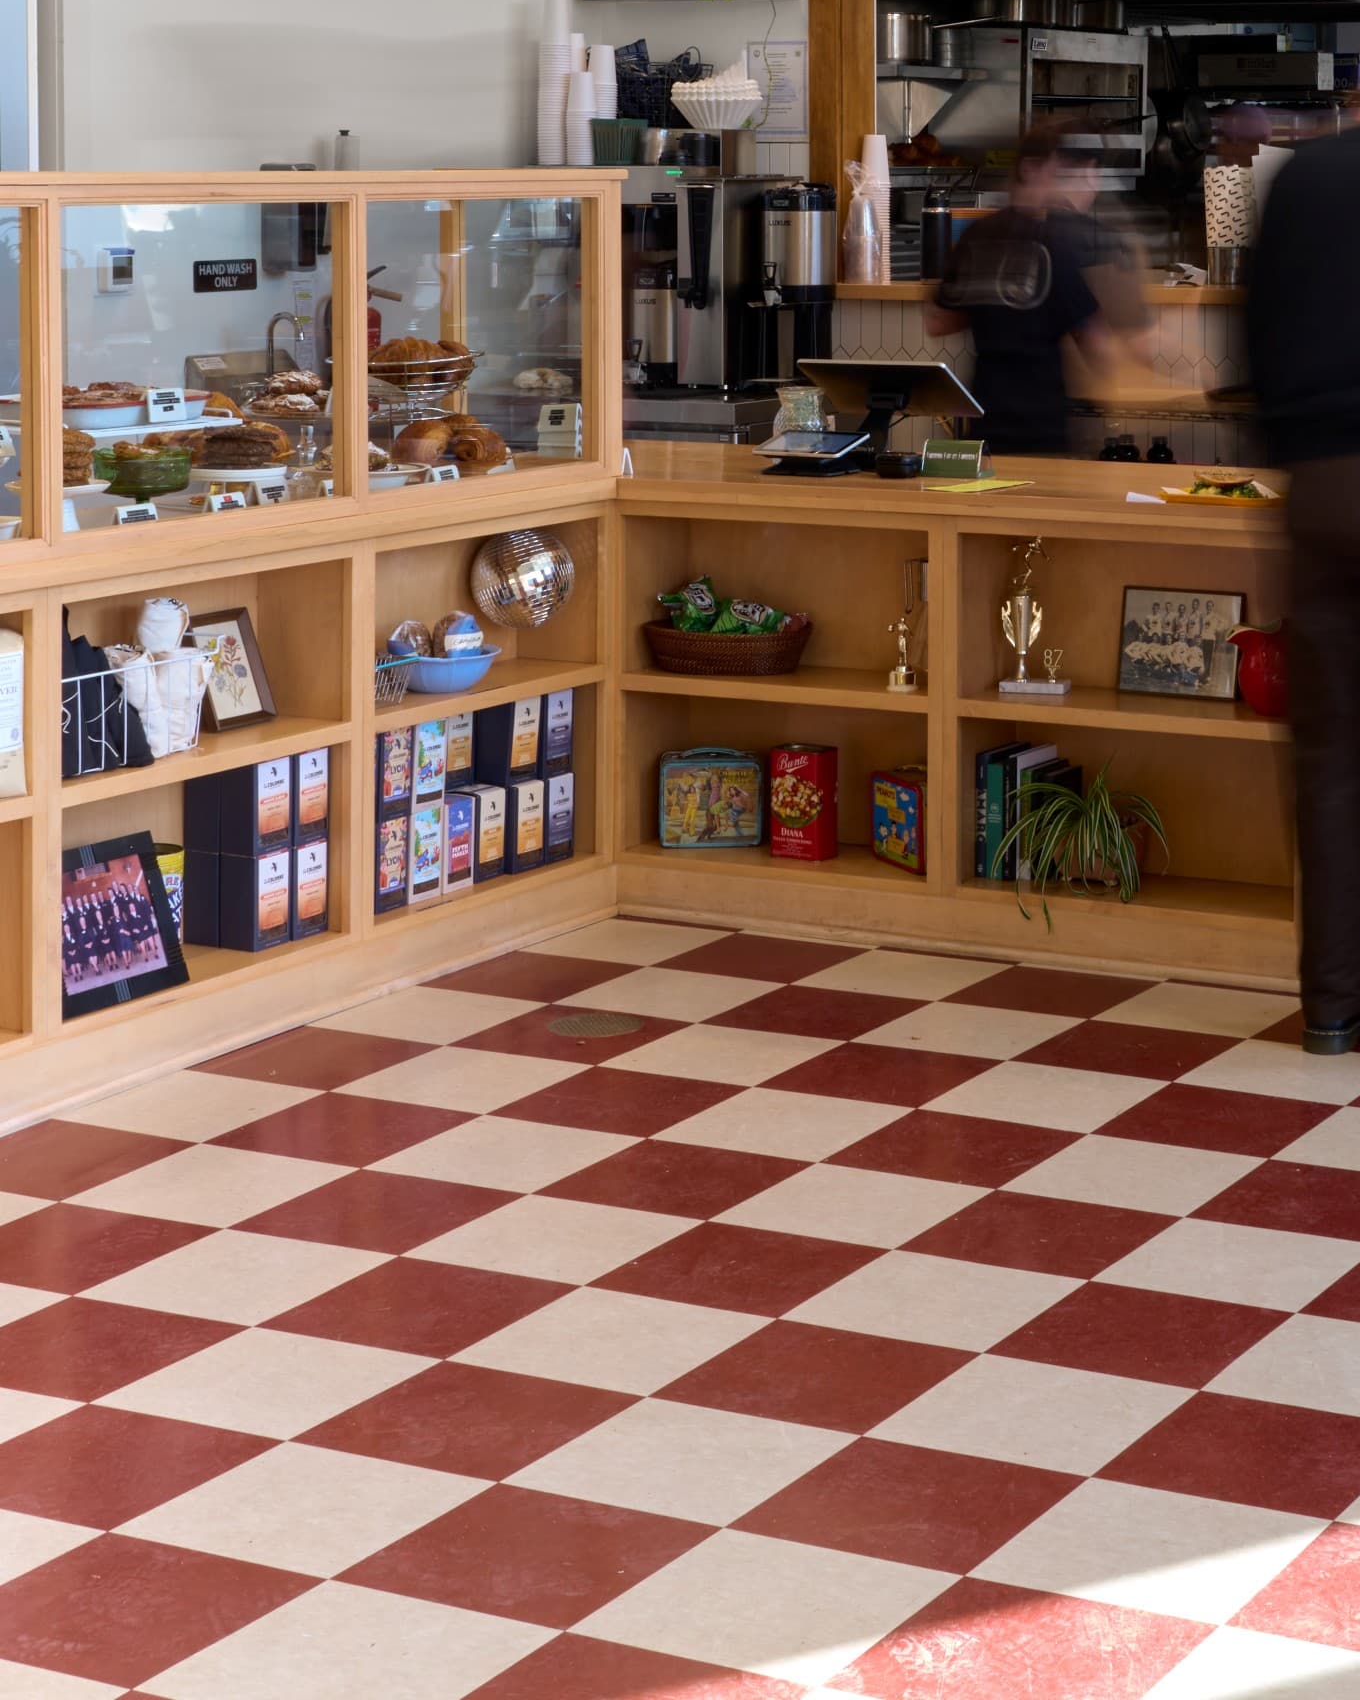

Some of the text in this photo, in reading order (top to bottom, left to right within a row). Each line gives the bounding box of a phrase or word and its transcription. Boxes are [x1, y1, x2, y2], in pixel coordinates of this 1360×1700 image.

[199, 262, 253, 276] HAND WASH
[214, 276, 238, 288] ONLY
[1044, 649, 1064, 668] 87
[781, 827, 803, 838] DIANA
